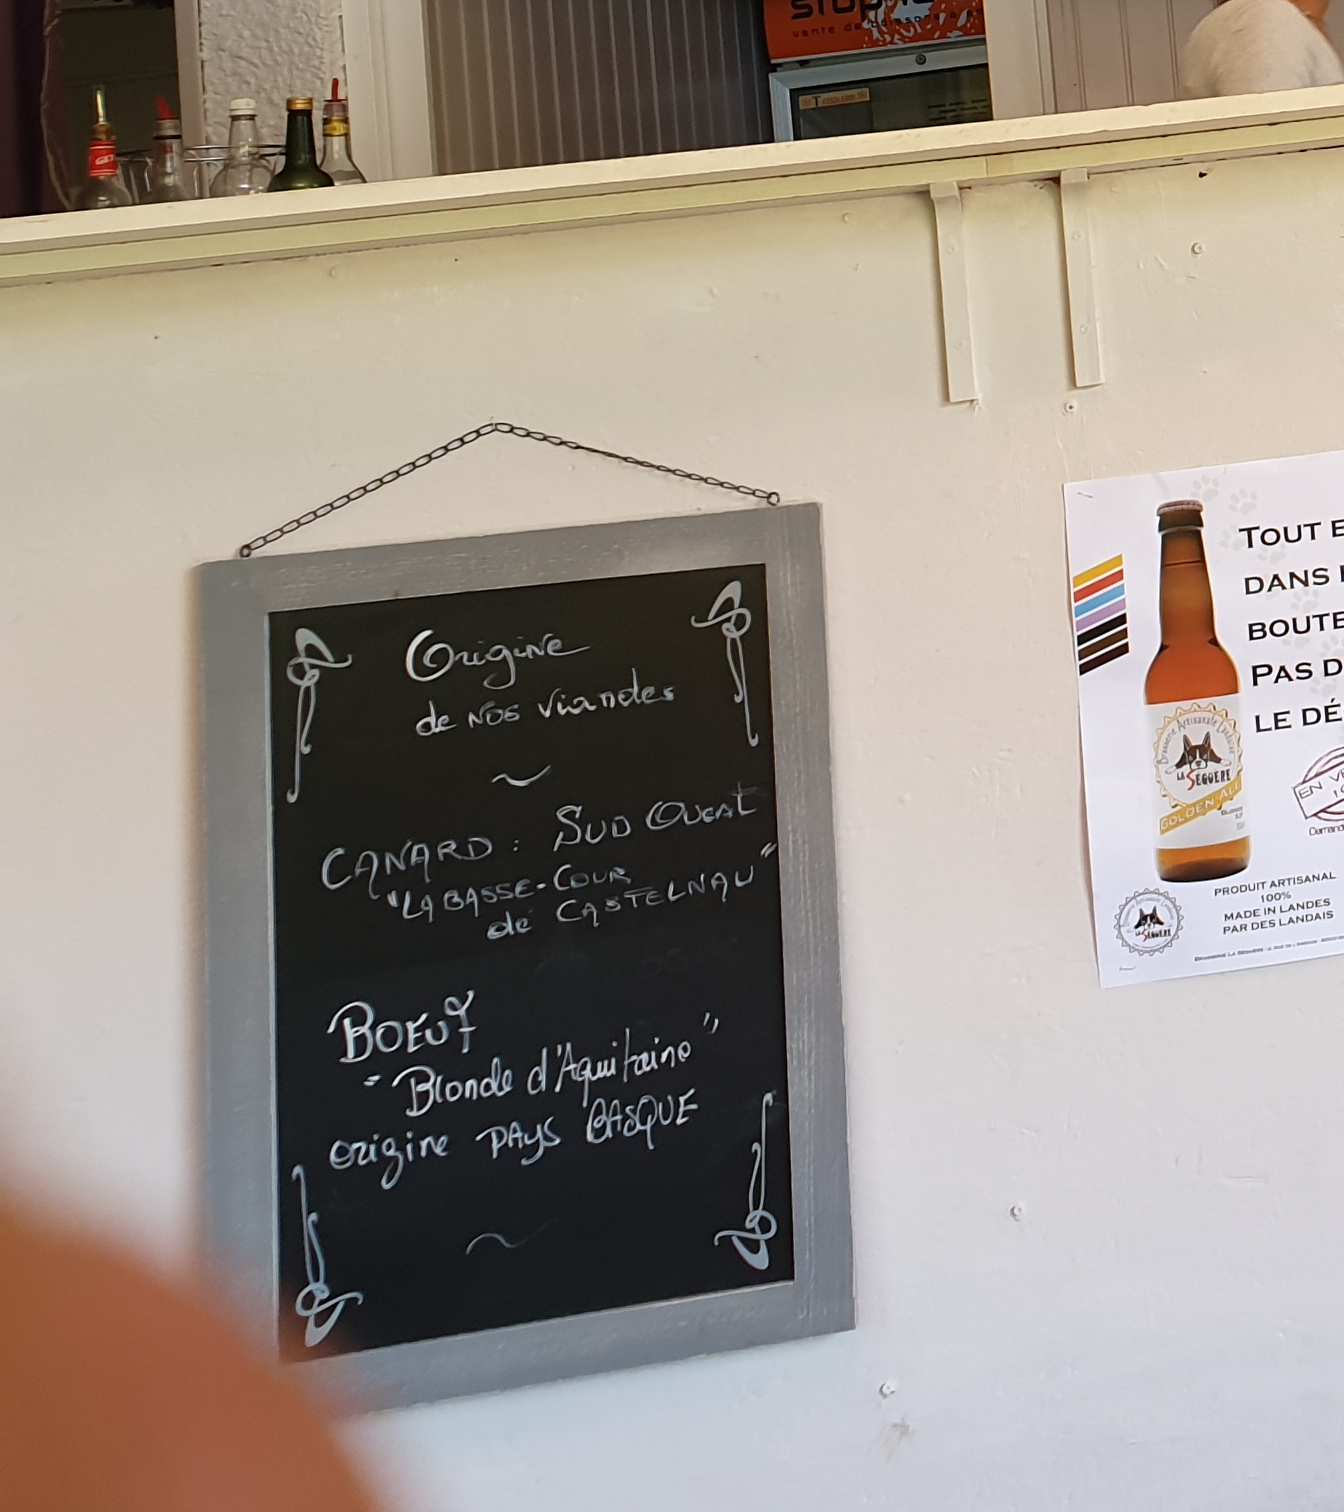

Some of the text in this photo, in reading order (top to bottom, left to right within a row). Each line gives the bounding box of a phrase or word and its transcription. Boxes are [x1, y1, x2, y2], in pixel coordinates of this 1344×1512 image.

[792, 25, 836, 38] vente
[844, 22, 862, 33] de
[405, 628, 593, 691] Origine
[415, 699, 458, 737] de
[1254, 710, 1293, 734] LE
[1298, 781, 1323, 801] EN
[1160, 796, 1215, 830] GOLDEN
[321, 836, 494, 901] CANARD
[1213, 870, 1337, 897] PRODUIT ARTISANAL
[1260, 890, 1292, 904] 100%
[1222, 910, 1335, 936] PAR DES LANDAIS
[1223, 897, 1332, 923] MADE IN LANDES
[486, 908, 534, 941] de
[328, 1129, 450, 1191] origine
[585, 1087, 700, 1151] BASQUE
